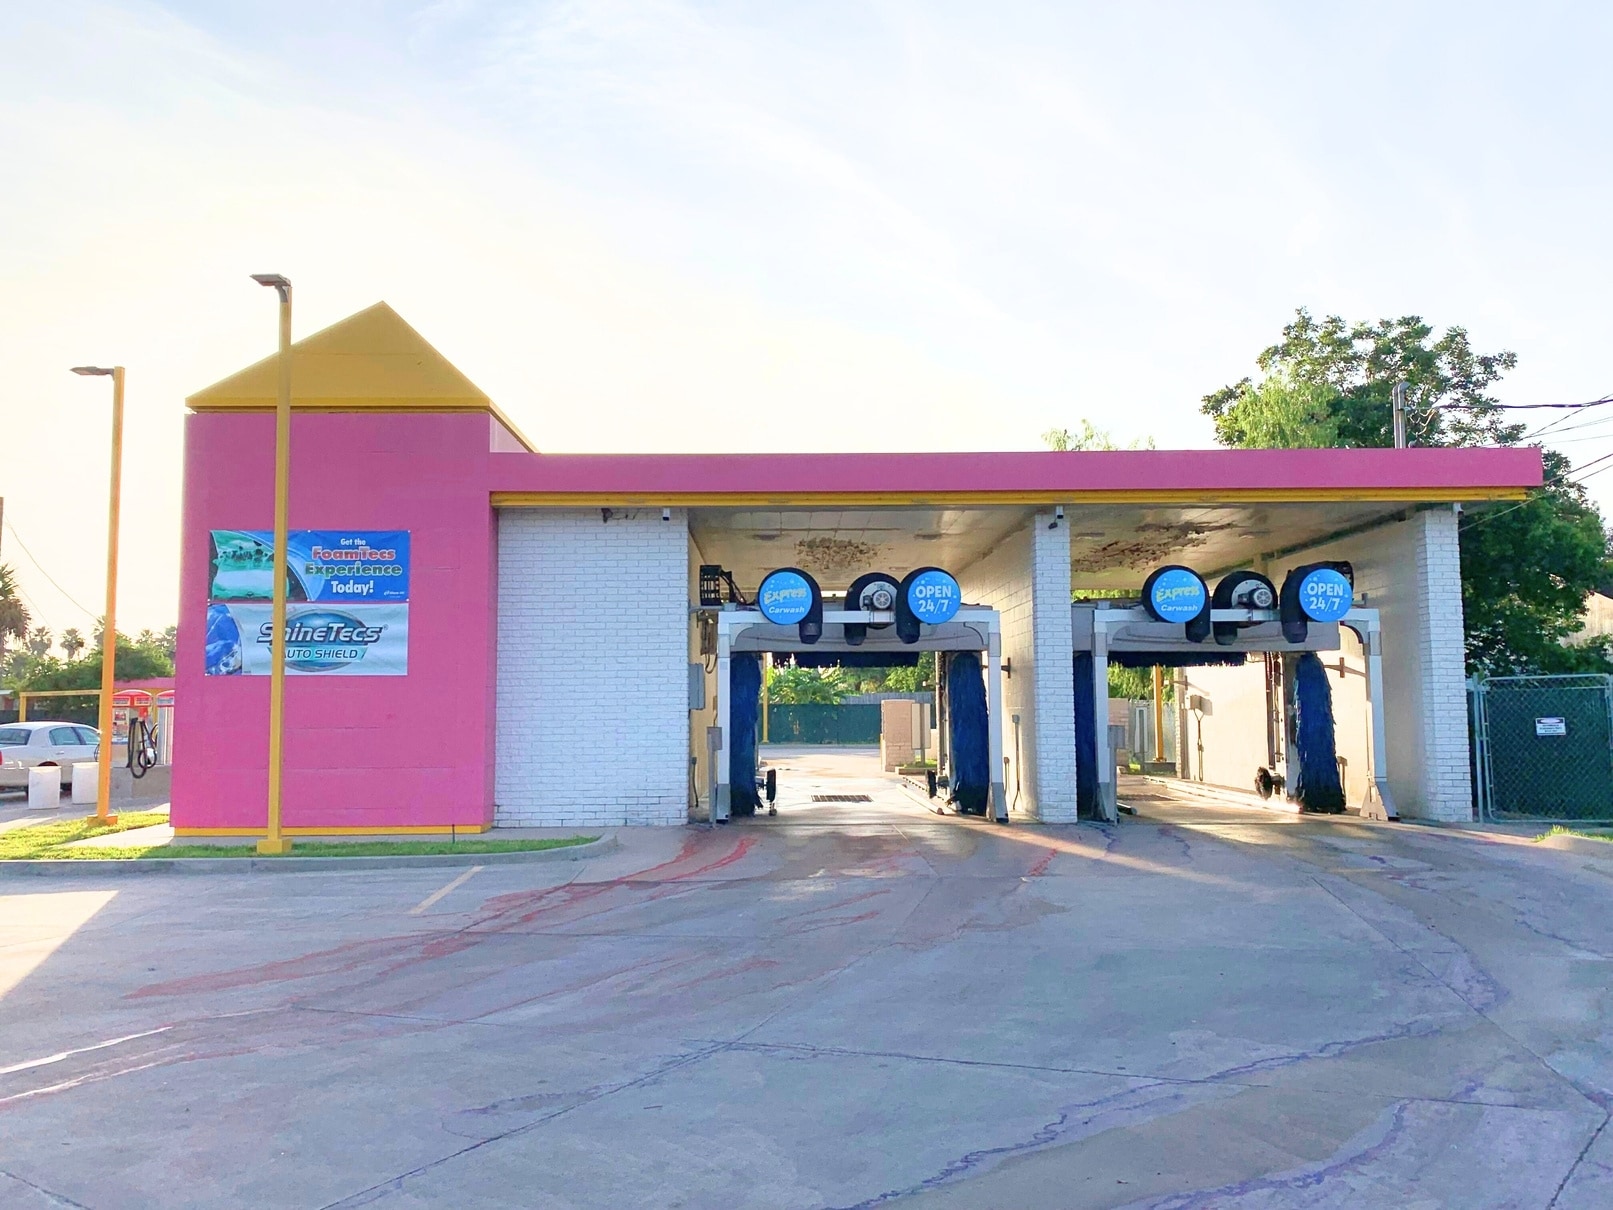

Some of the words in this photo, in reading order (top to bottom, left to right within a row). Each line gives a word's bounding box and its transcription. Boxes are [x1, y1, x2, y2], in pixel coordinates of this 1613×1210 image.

[312, 546, 396, 560] FoamTecs
[304, 561, 402, 579] Experience
[331, 580, 374, 595] Today!
[915, 585, 952, 598] OPEN
[1307, 582, 1344, 596] OPEN
[768, 606, 805, 614] Carwash
[918, 599, 949, 614] 24/7
[1309, 596, 1341, 612] 24/7
[284, 649, 312, 659] UTO
[314, 649, 358, 659] SHIELD
